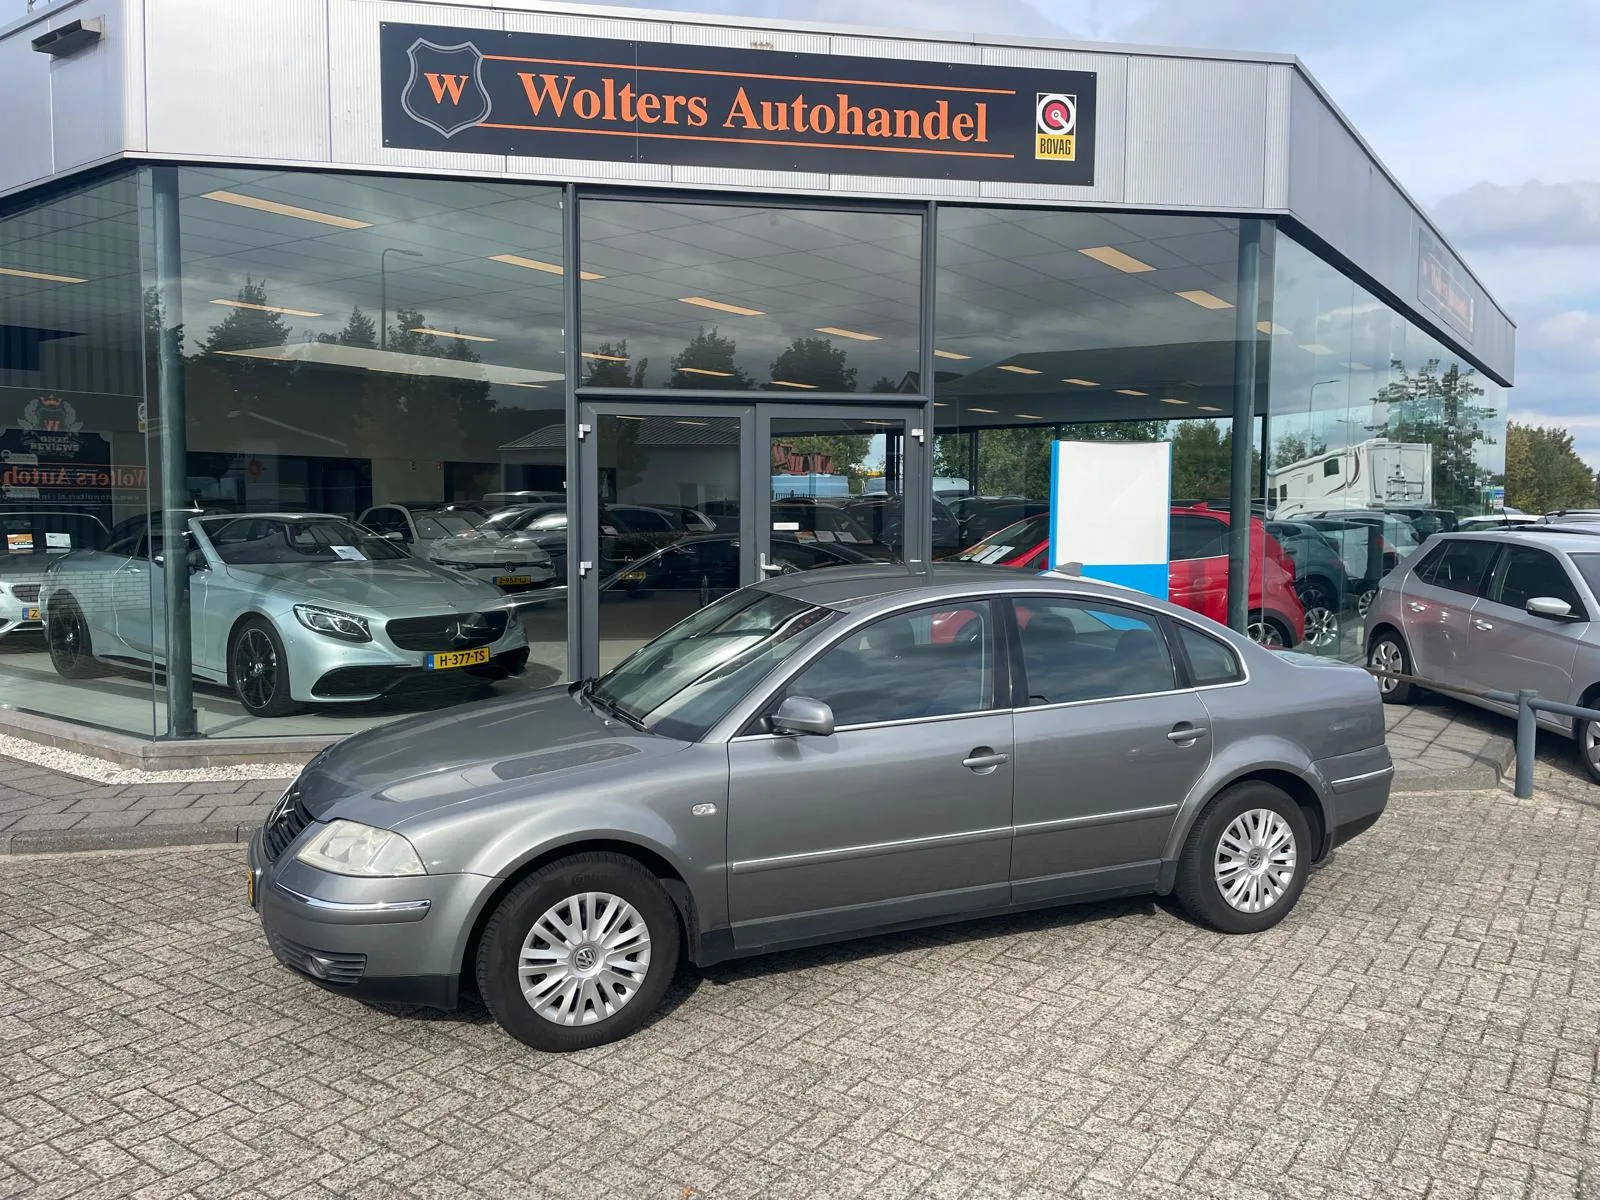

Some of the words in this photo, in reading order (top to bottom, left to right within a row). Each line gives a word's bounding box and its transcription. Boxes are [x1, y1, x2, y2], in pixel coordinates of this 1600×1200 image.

[425, 72, 469, 105] W
[517, 72, 709, 126] Wolters
[722, 86, 988, 143] Autohandel
[1040, 138, 1072, 155] BOVAG
[440, 651, 485, 666] H-377-TS
